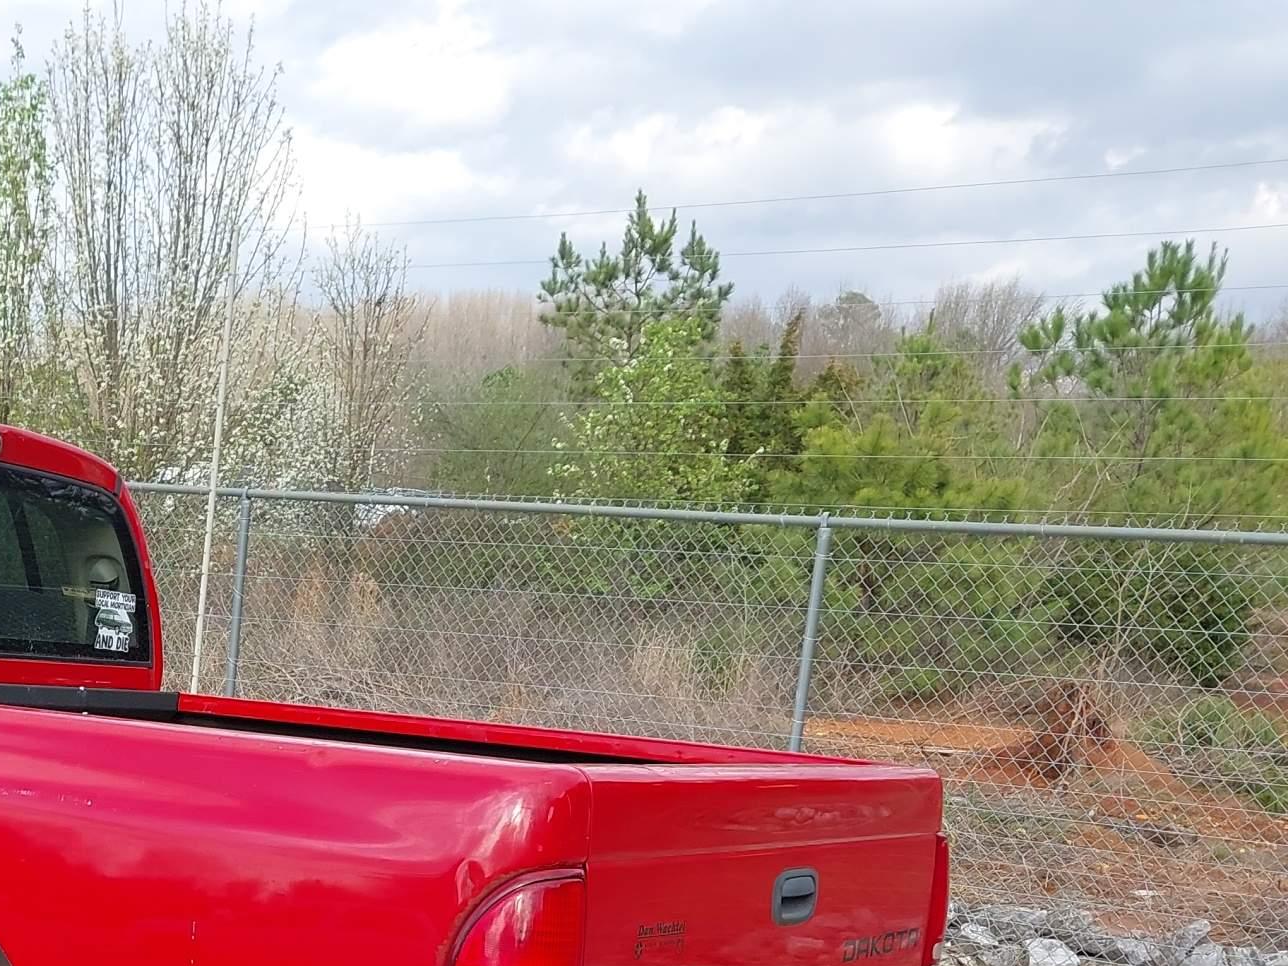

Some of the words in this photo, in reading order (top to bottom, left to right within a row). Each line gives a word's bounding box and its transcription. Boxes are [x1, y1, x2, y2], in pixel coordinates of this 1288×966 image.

[97, 590, 120, 601] SUPPORT
[121, 594, 135, 603] YOUR
[110, 600, 135, 612] MORTICIAN
[95, 634, 113, 649] AND
[116, 636, 129, 652] DIE
[842, 928, 919, 962] DAKOTA
